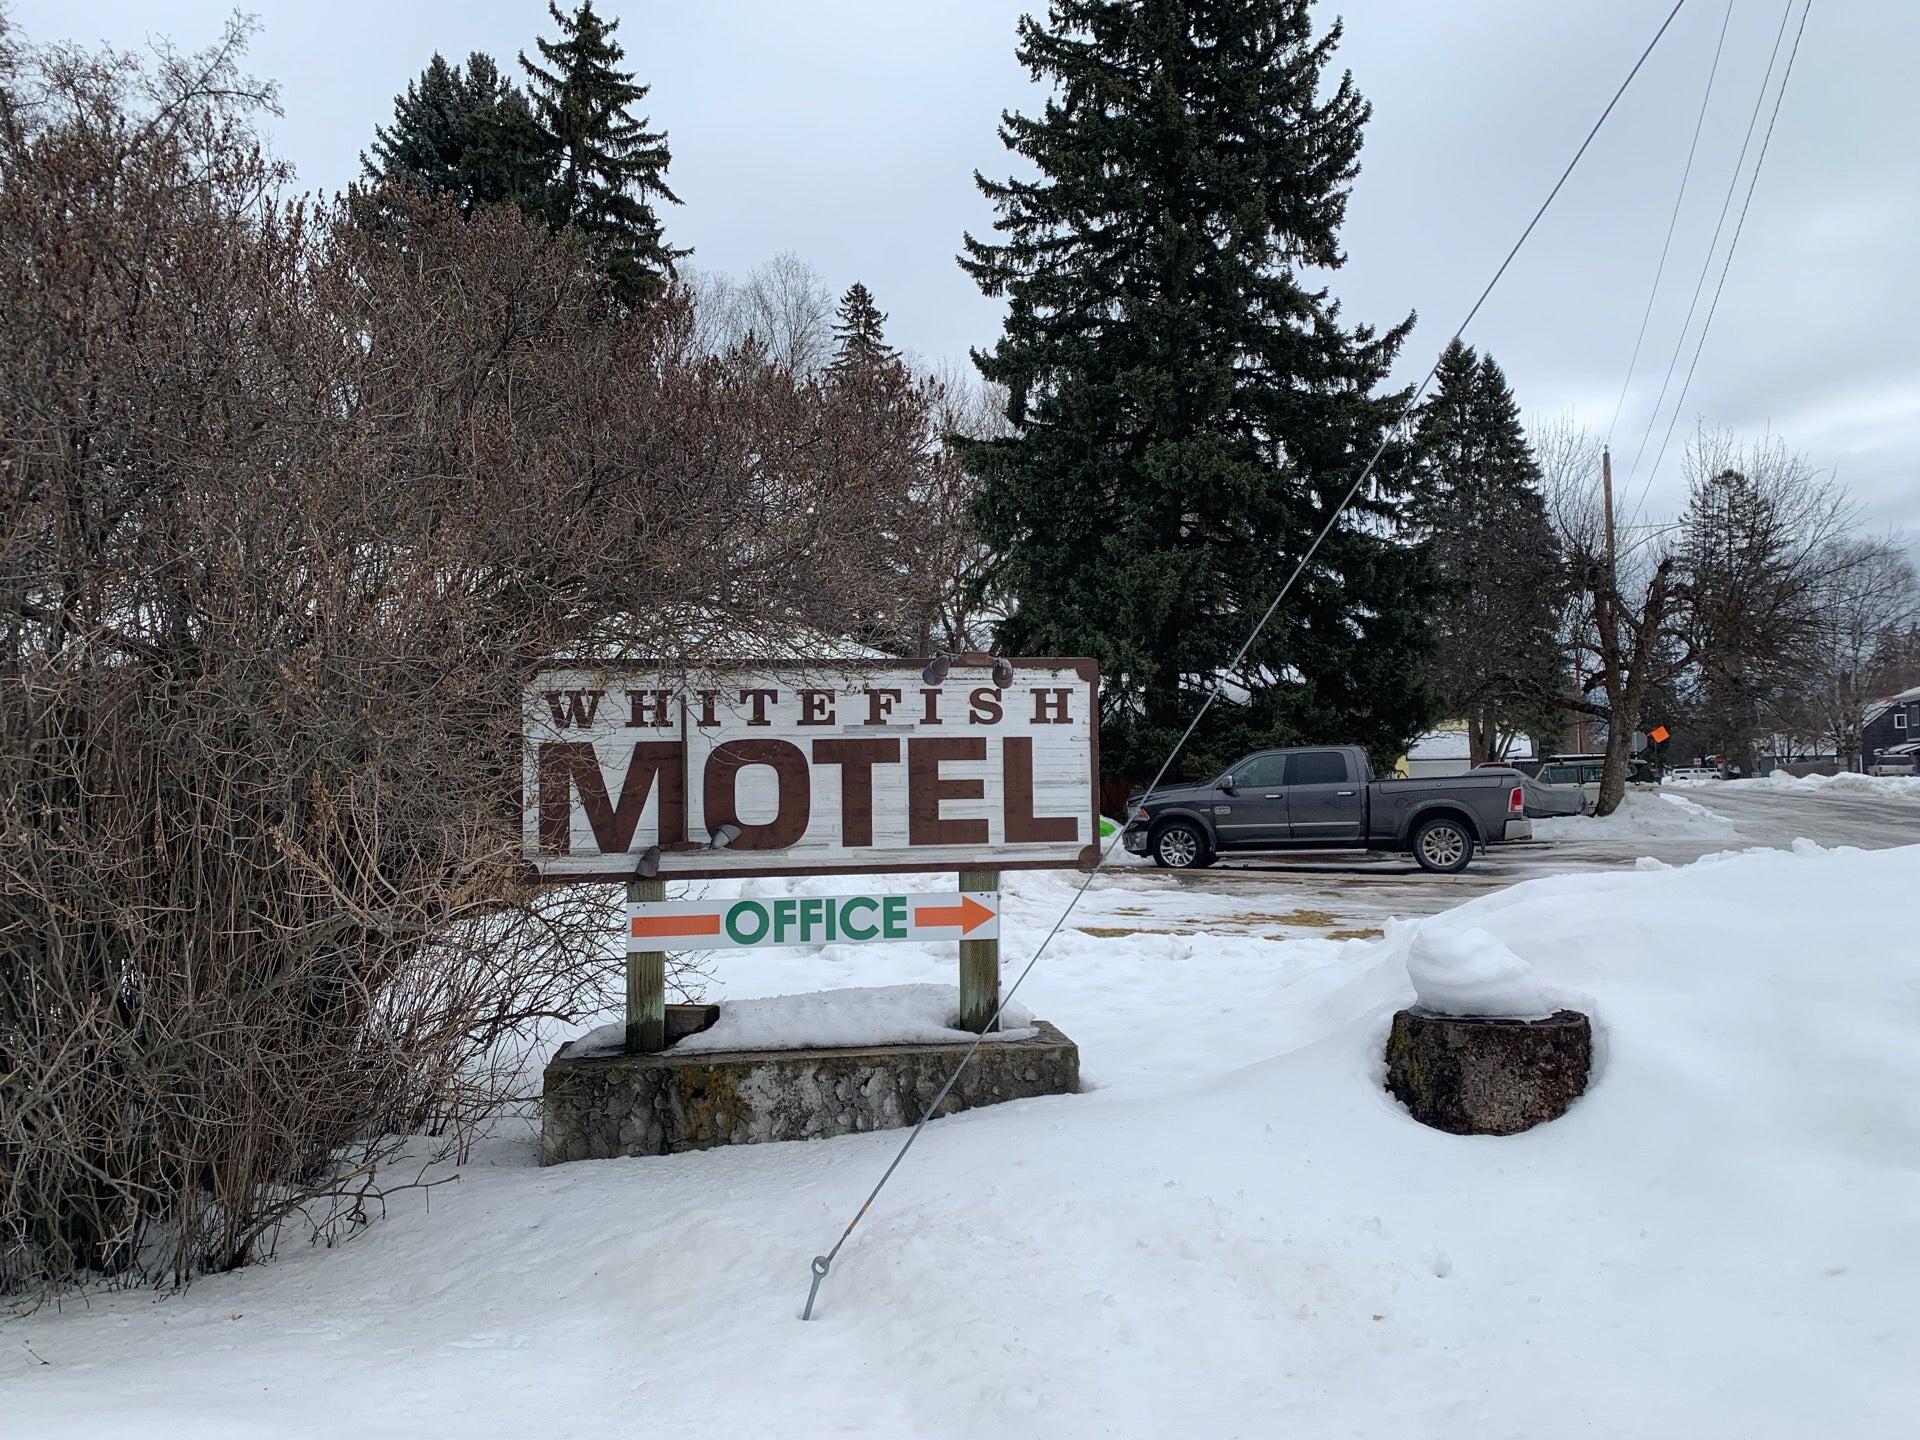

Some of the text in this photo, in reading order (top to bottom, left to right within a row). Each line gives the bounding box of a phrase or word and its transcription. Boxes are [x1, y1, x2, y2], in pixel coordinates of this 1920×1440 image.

[541, 687, 1074, 729] WHITEFISH
[538, 736, 1079, 854] MOTEL
[725, 896, 908, 945] OFFICE
